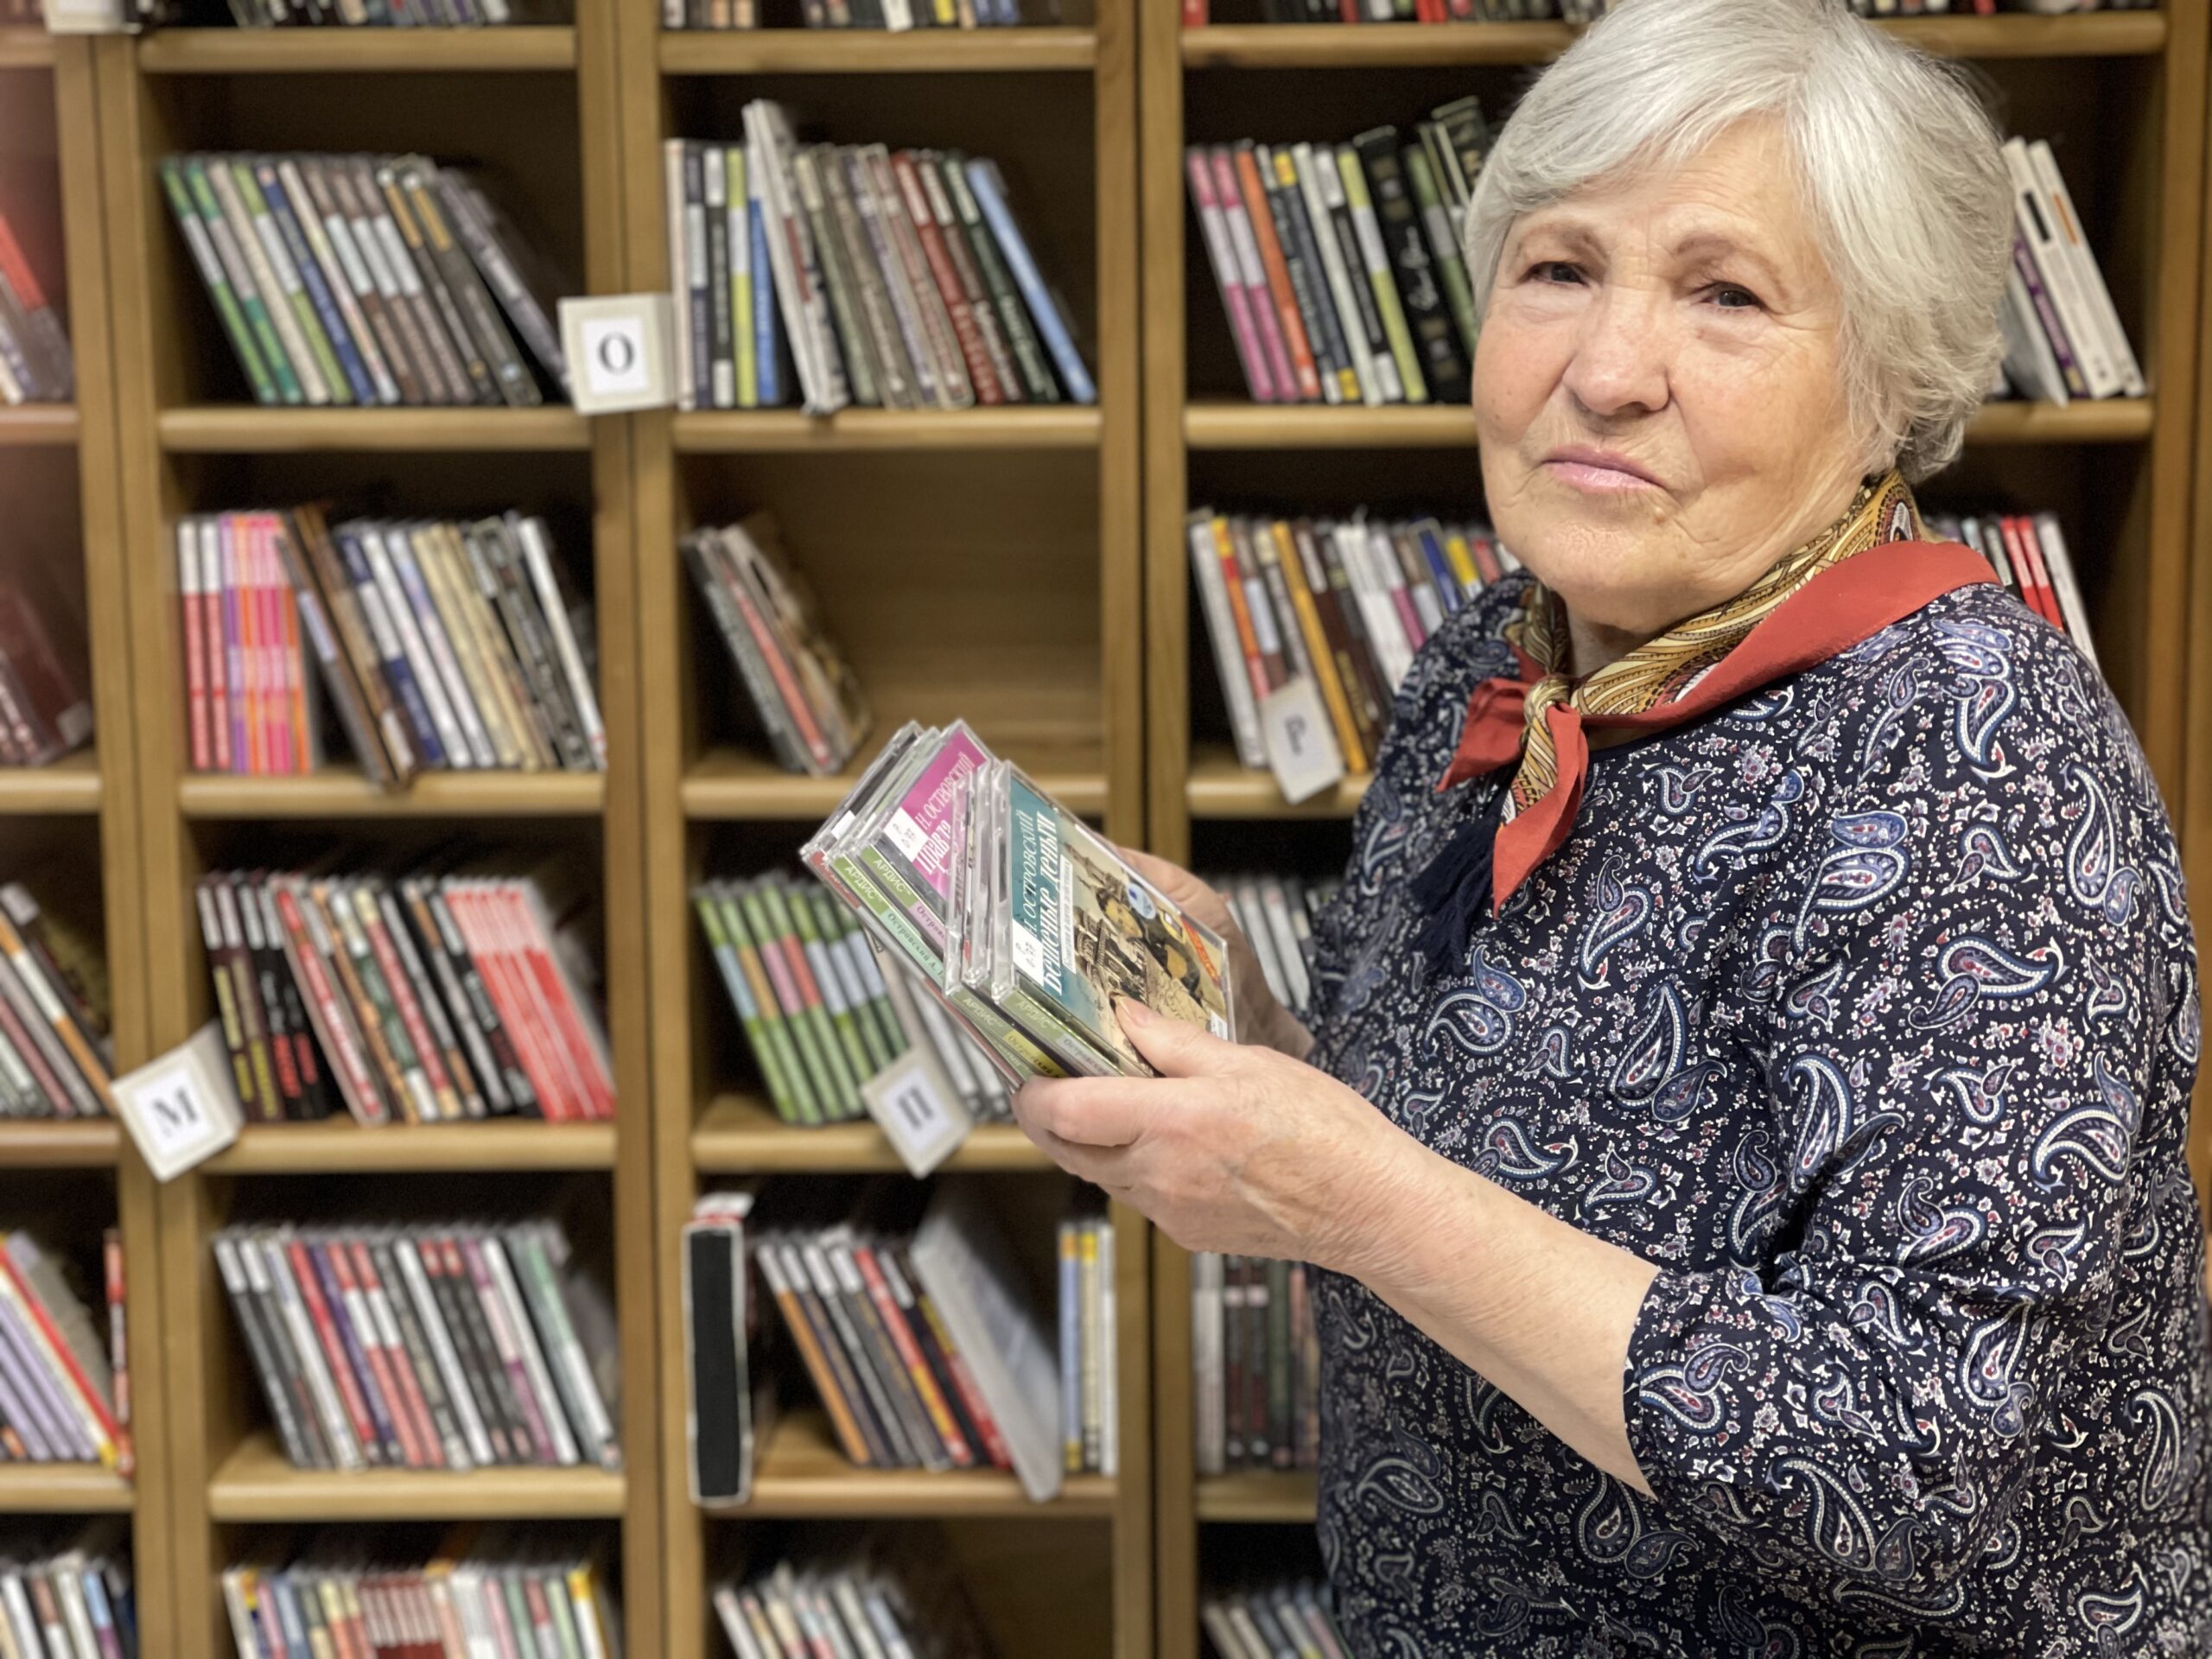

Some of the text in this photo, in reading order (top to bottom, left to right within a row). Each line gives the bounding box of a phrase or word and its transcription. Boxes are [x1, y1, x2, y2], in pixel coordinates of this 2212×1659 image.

[597, 330, 635, 376] О
[1015, 809, 1038, 919] ОСТРОВСКИЙ
[887, 912, 930, 962] Островский
[151, 1086, 198, 1139] М
